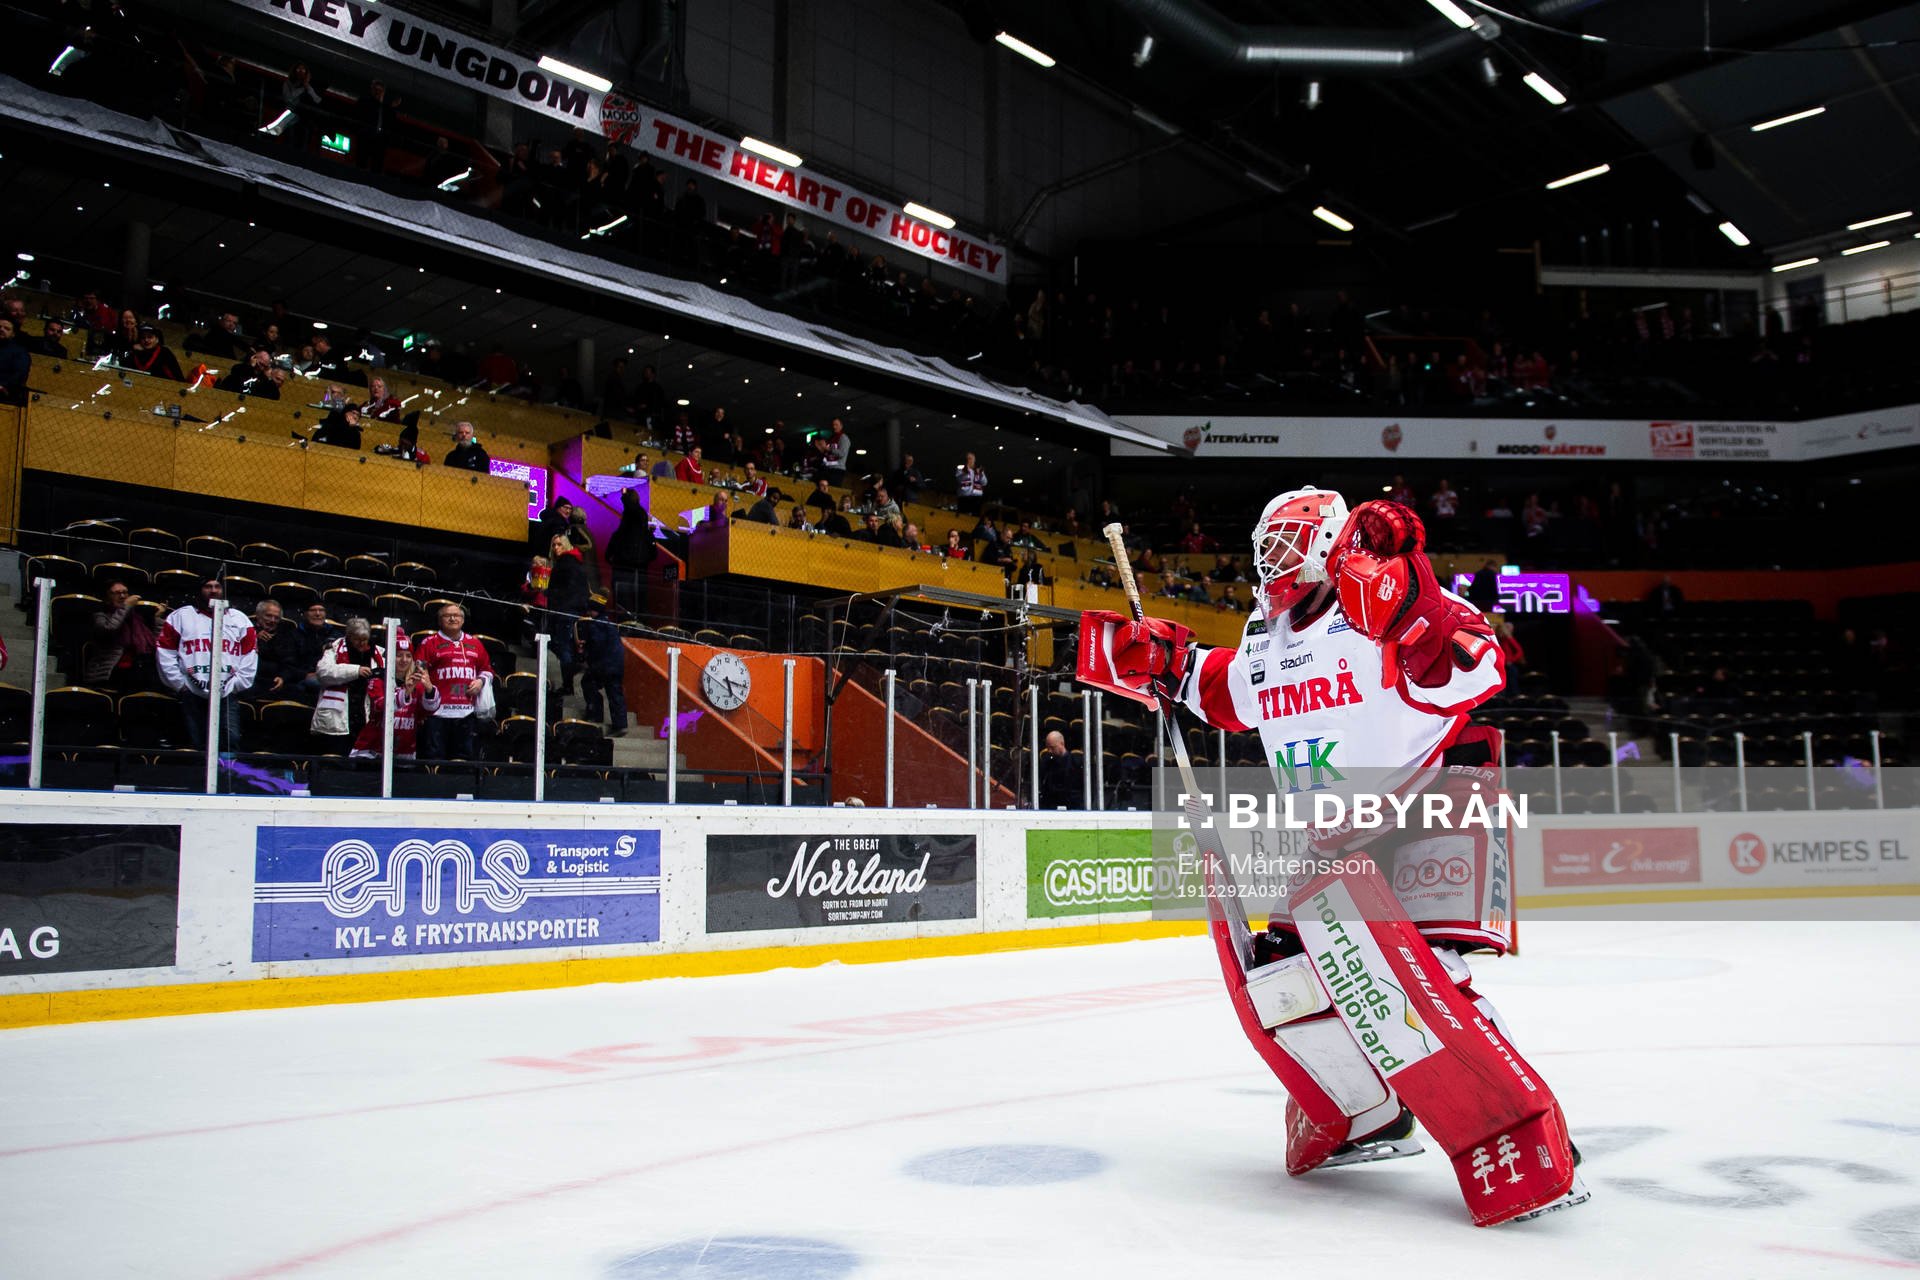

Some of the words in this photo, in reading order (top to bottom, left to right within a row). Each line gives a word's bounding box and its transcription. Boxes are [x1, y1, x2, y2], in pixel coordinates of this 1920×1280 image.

[387, 19, 590, 119] UNGDOM
[602, 110, 639, 121] MODO
[652, 118, 726, 168] THE
[729, 150, 844, 213] HEART
[846, 196, 887, 230] OF
[890, 213, 1002, 274] HOCKEY
[437, 666, 476, 680] TIMR
[1258, 657, 1364, 721] TIMRÅ
[1275, 737, 1348, 795] NHK
[547, 844, 609, 860] Transport
[547, 860, 558, 873] &
[561, 860, 609, 876] Logistic
[766, 841, 931, 898] Norrland
[834, 839, 850, 850] THE
[853, 839, 880, 850] GREAT
[1490, 806, 1507, 915] PEA
[1772, 840, 1870, 863] KEMPES
[1879, 840, 1909, 860] EL
[322, 839, 530, 918] ems
[1050, 865, 1186, 898] CASHBUDDY
[335, 926, 386, 949] KYL-
[391, 924, 407, 947] &
[415, 918, 600, 946] FRYSTRANSPORTER
[1313, 891, 1391, 1021] norrlands
[1398, 946, 1463, 1030] BAUER
[1473, 1016, 1537, 1092] BAUER
